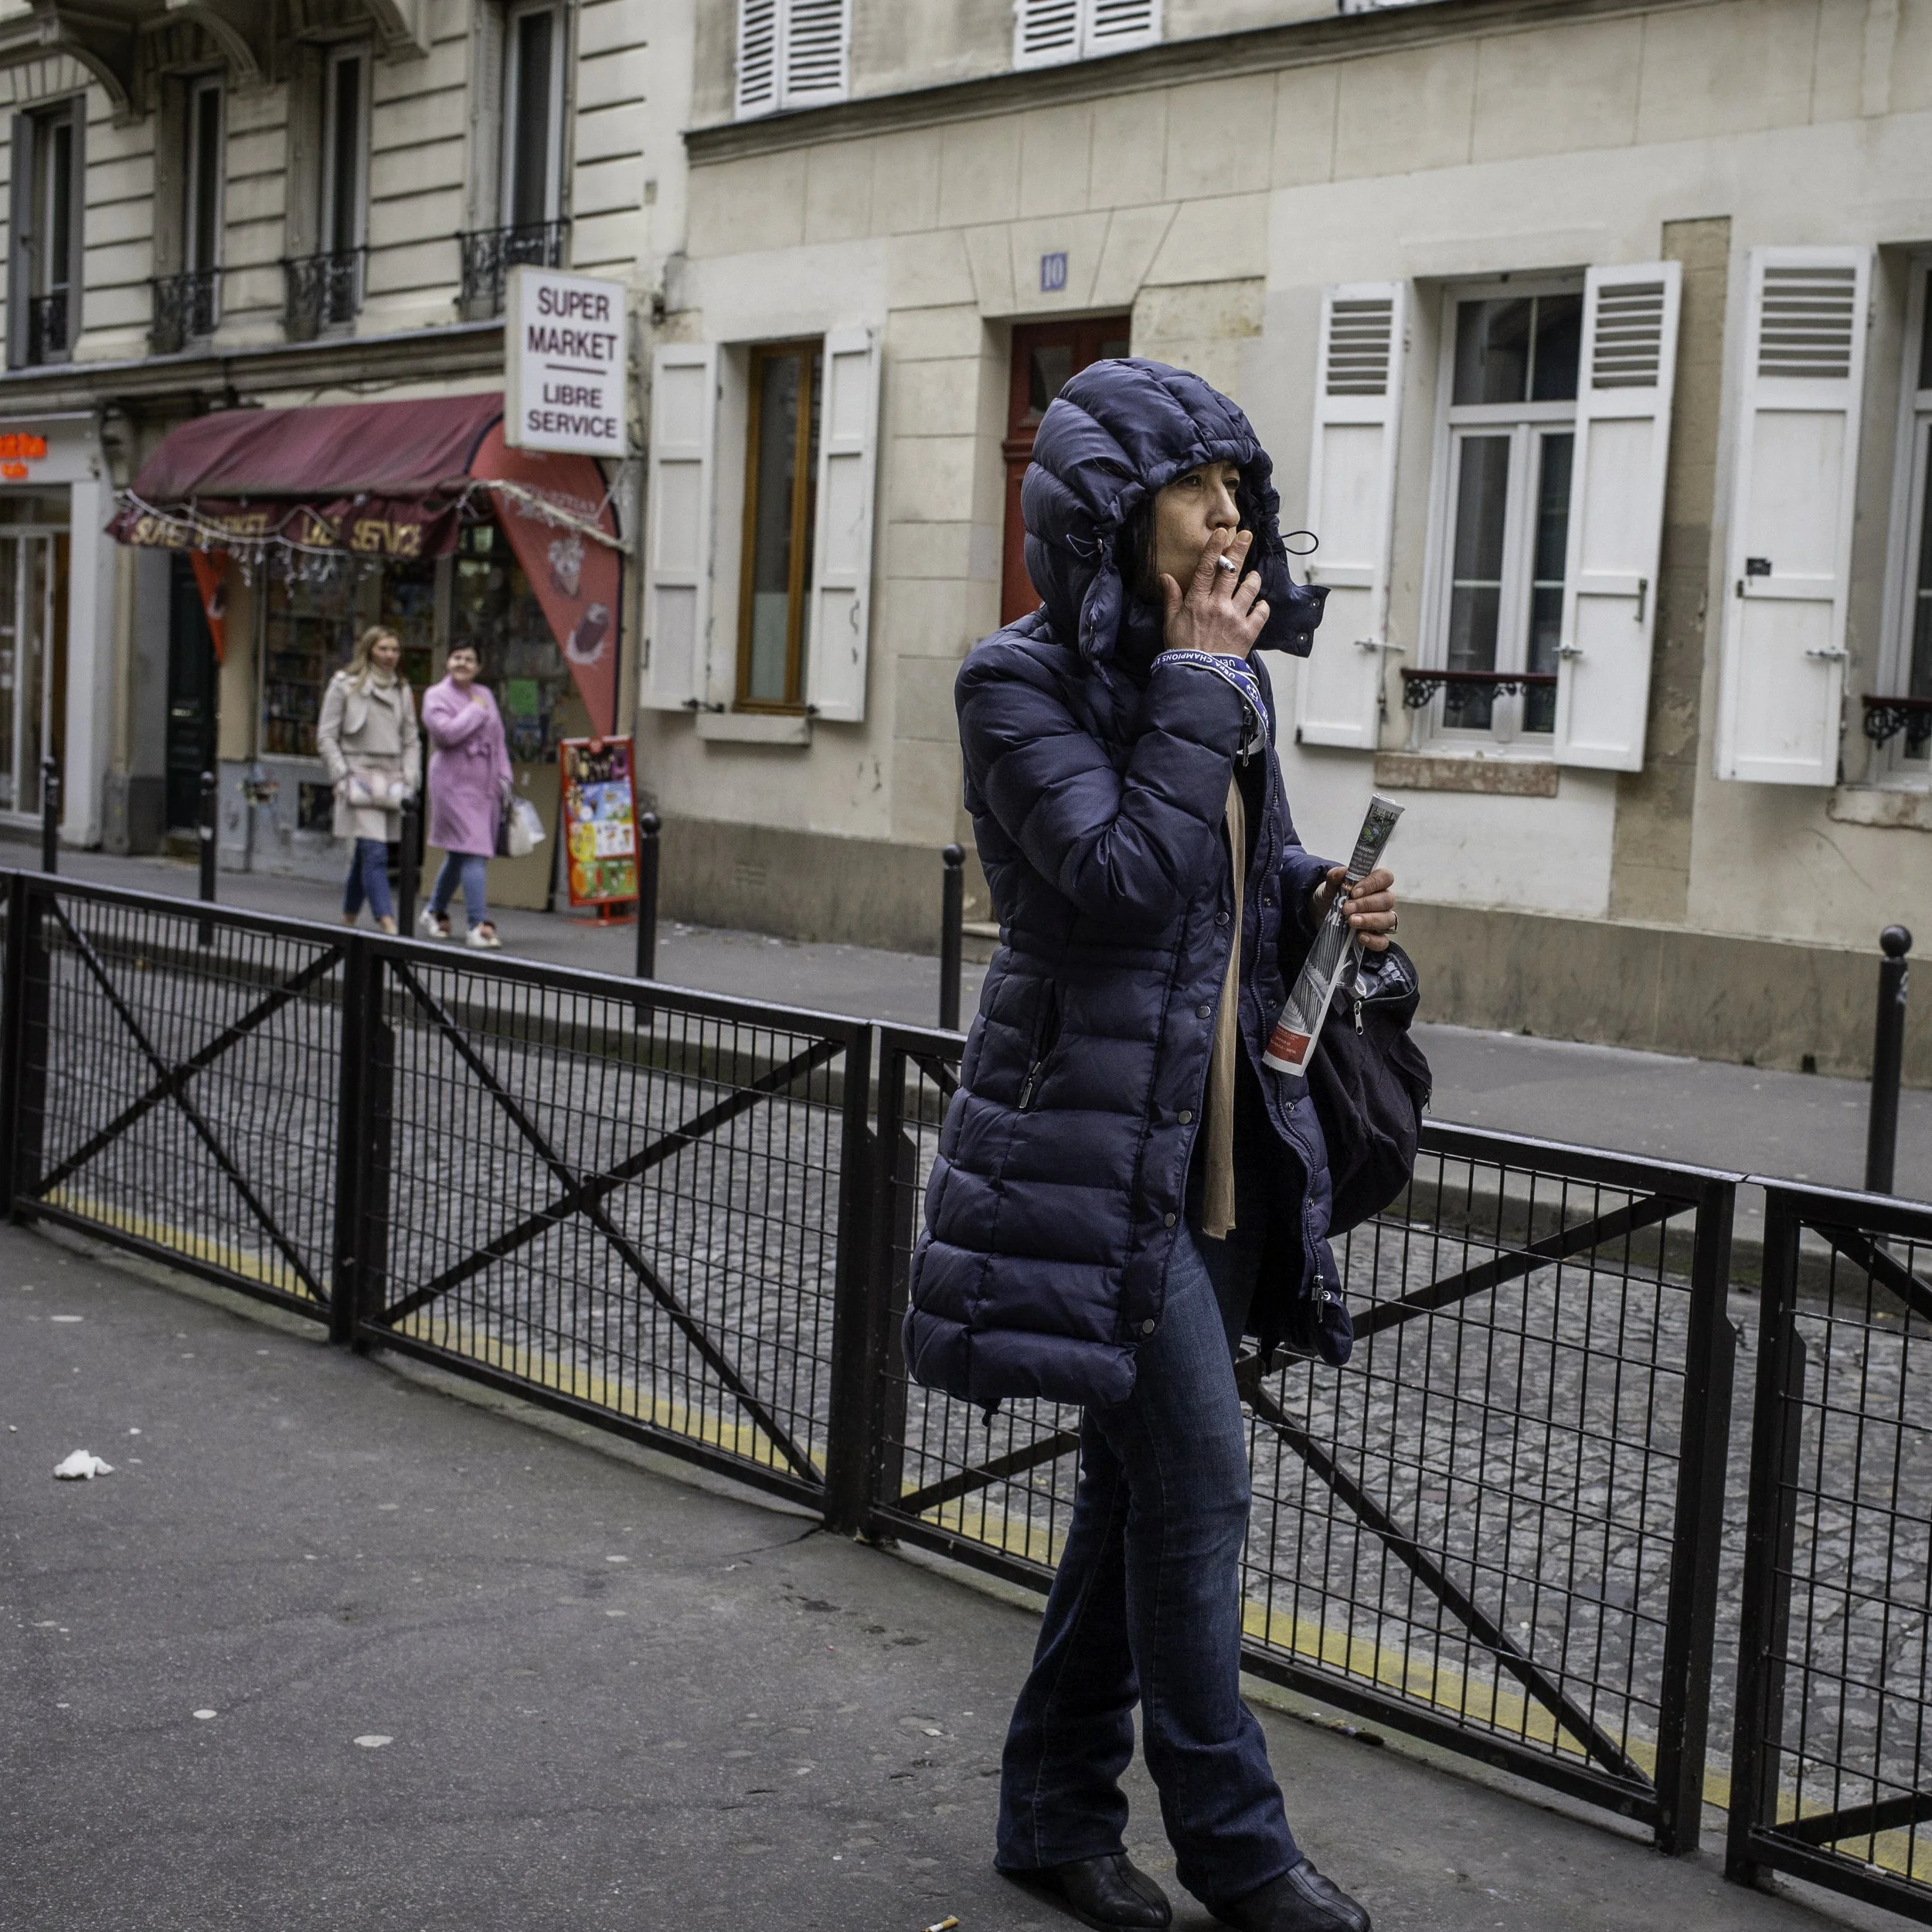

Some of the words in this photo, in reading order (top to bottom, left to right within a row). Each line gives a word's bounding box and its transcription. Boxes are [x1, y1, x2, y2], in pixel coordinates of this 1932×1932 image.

[1045, 257, 1064, 287] 10
[538, 286, 609, 321] SUPER
[529, 325, 617, 361] MARKET
[543, 383, 603, 409] LIBRE
[529, 410, 616, 438] SERVICE
[1162, 652, 1213, 665] CHAMPIONS
[1216, 662, 1236, 679] UEFA
